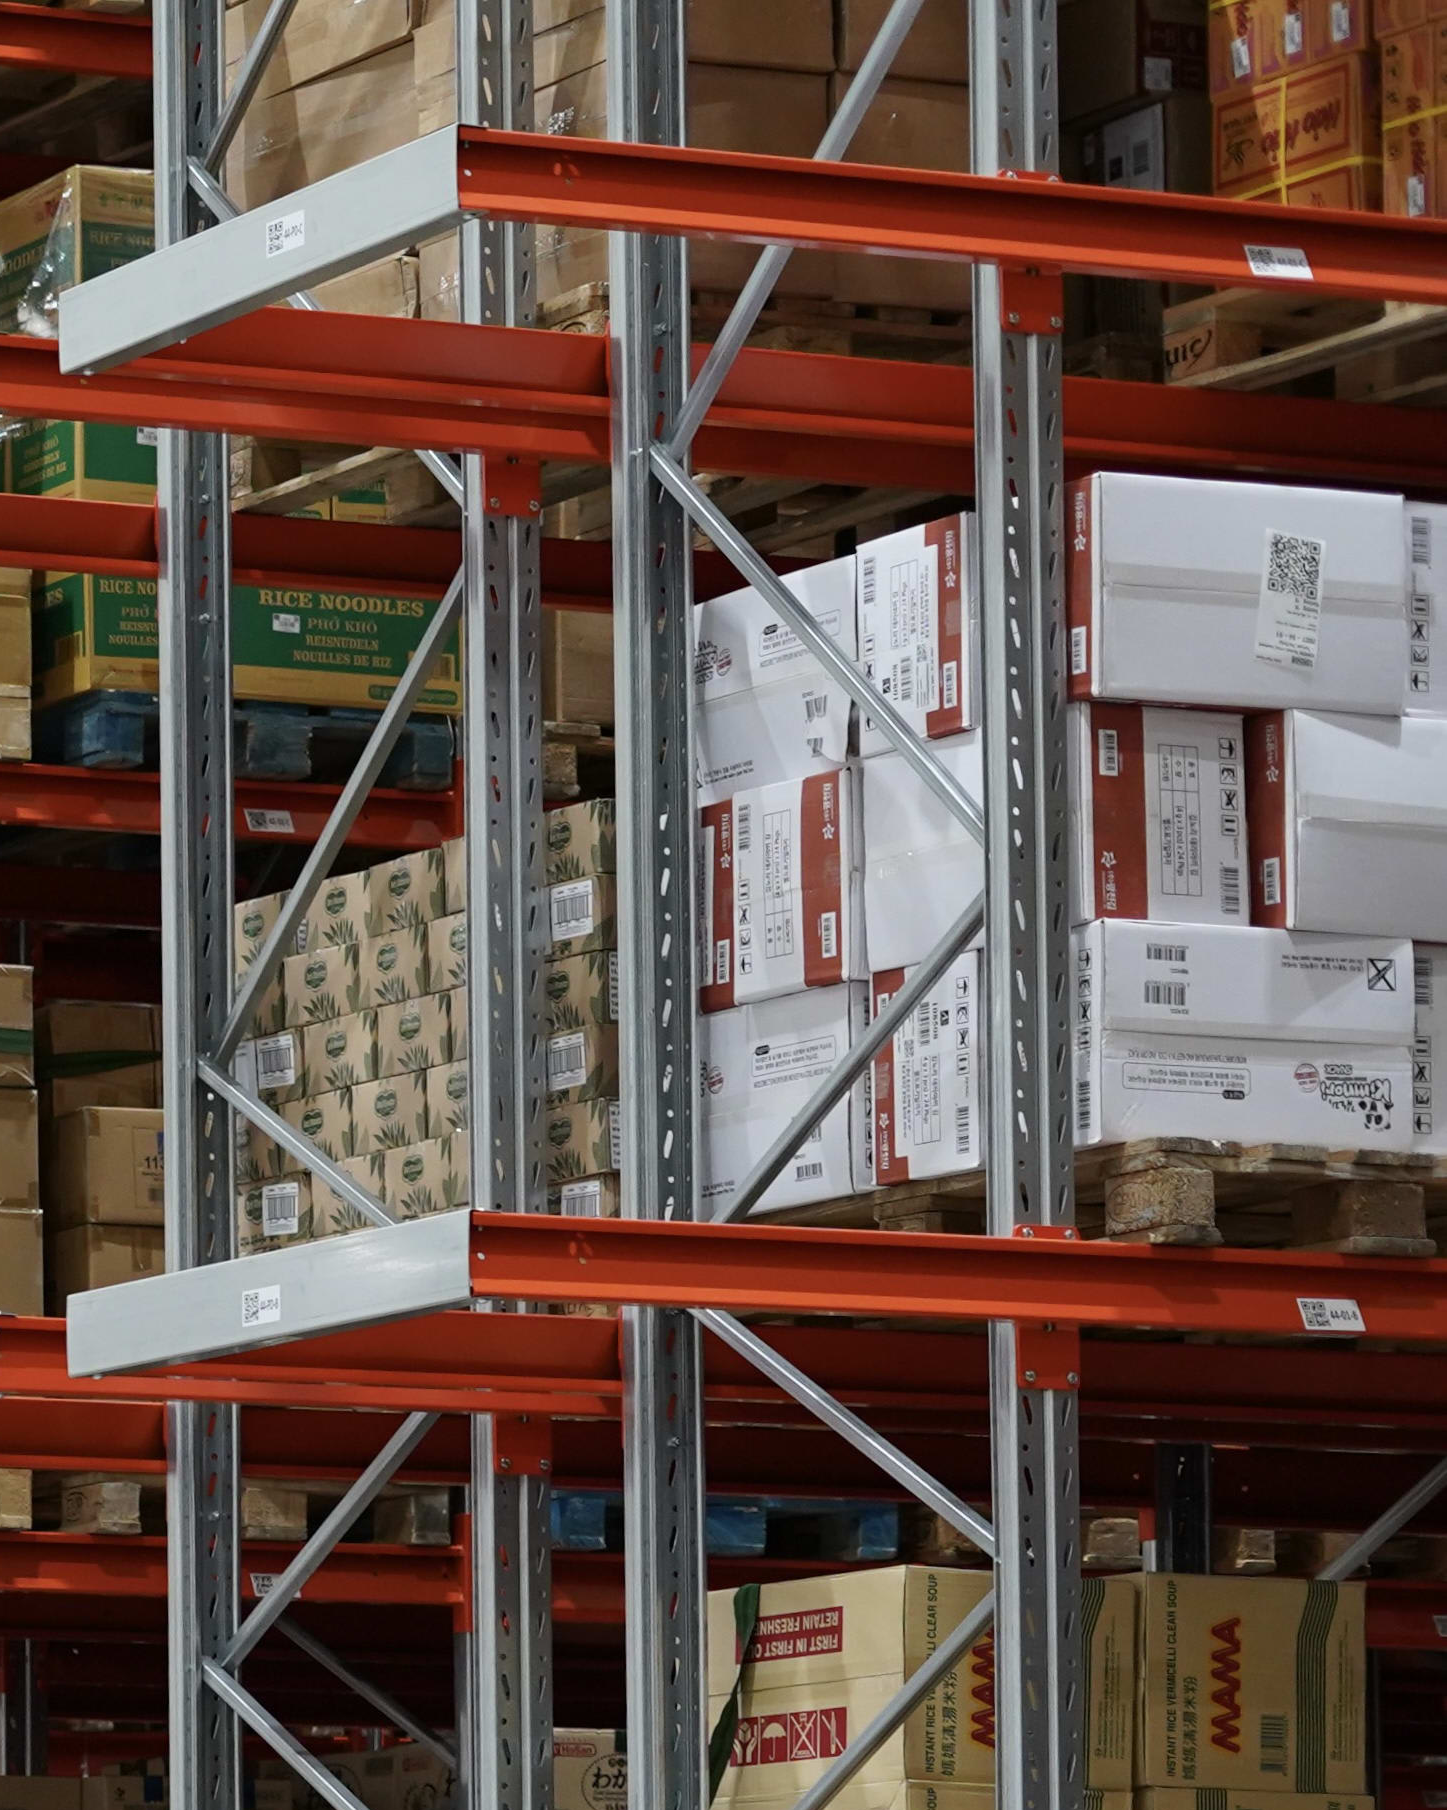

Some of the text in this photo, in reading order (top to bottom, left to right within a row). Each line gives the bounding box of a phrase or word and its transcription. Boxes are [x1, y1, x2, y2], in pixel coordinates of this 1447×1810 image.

[99, 578, 133, 595] RICE
[259, 589, 424, 618] RICE NOODLES
[305, 633, 379, 652] REISNUDELN
[293, 650, 392, 669] NOUILLES DE RIZ
[1320, 1078, 1393, 1102] Kimnori
[802, 1610, 839, 1631] RETAIN
[765, 1634, 838, 1657] FIRST IN FIRST
[925, 1574, 936, 1773] INSTANT RICE CLEAR SOUP
[1166, 1580, 1177, 1776] INSTANT RICE VERMICELLI CLEAR SOUP
[1210, 1617, 1242, 1754] MAMA
